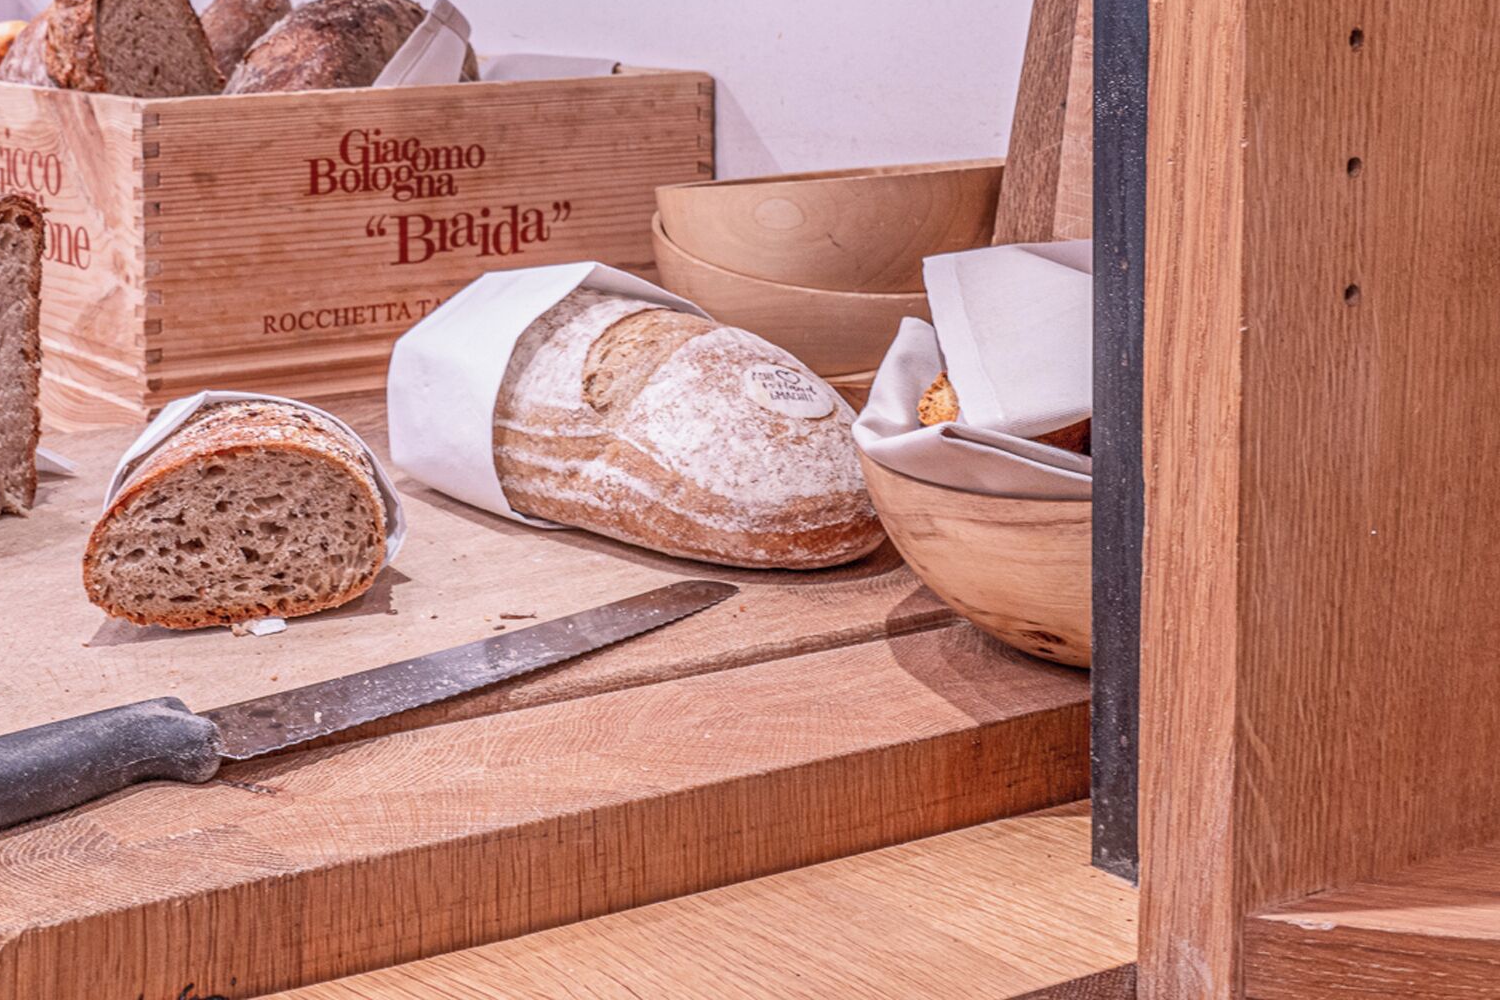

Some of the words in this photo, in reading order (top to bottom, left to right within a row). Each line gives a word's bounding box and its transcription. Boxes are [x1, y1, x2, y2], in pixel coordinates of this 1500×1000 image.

[339, 128, 486, 173] Giacomo
[302, 157, 458, 202] Bologna
[263, 301, 412, 335] ROCCHETTA
